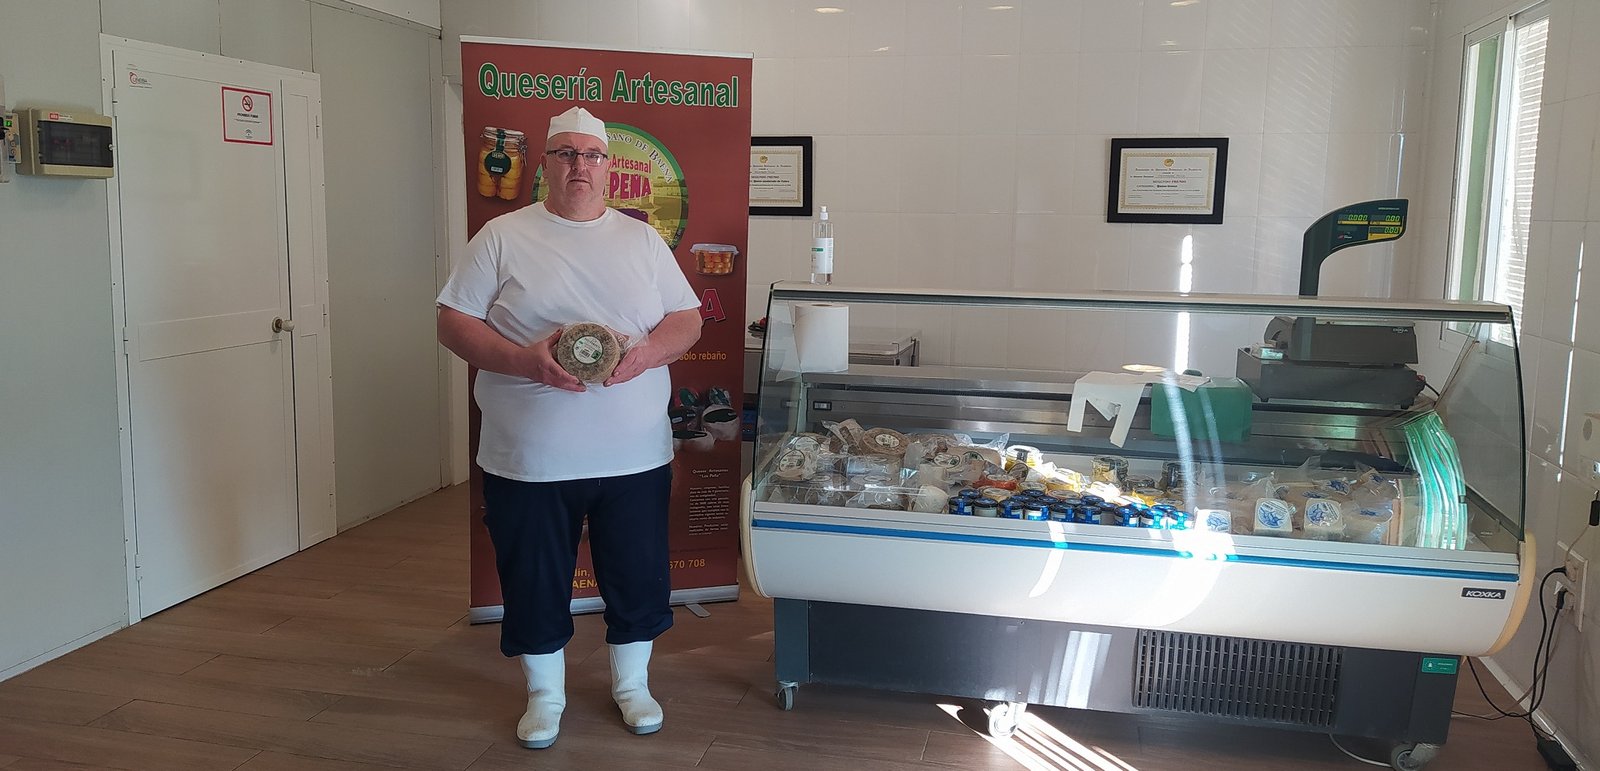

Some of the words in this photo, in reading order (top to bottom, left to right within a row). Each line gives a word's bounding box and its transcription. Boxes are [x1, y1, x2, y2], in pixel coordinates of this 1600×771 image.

[479, 62, 602, 100] Quesería
[610, 70, 739, 107] Artesanal
[612, 154, 651, 174] Artesanal
[698, 350, 727, 360] rebaño
[688, 558, 705, 568] 708
[1465, 590, 1502, 599] KOXKA
